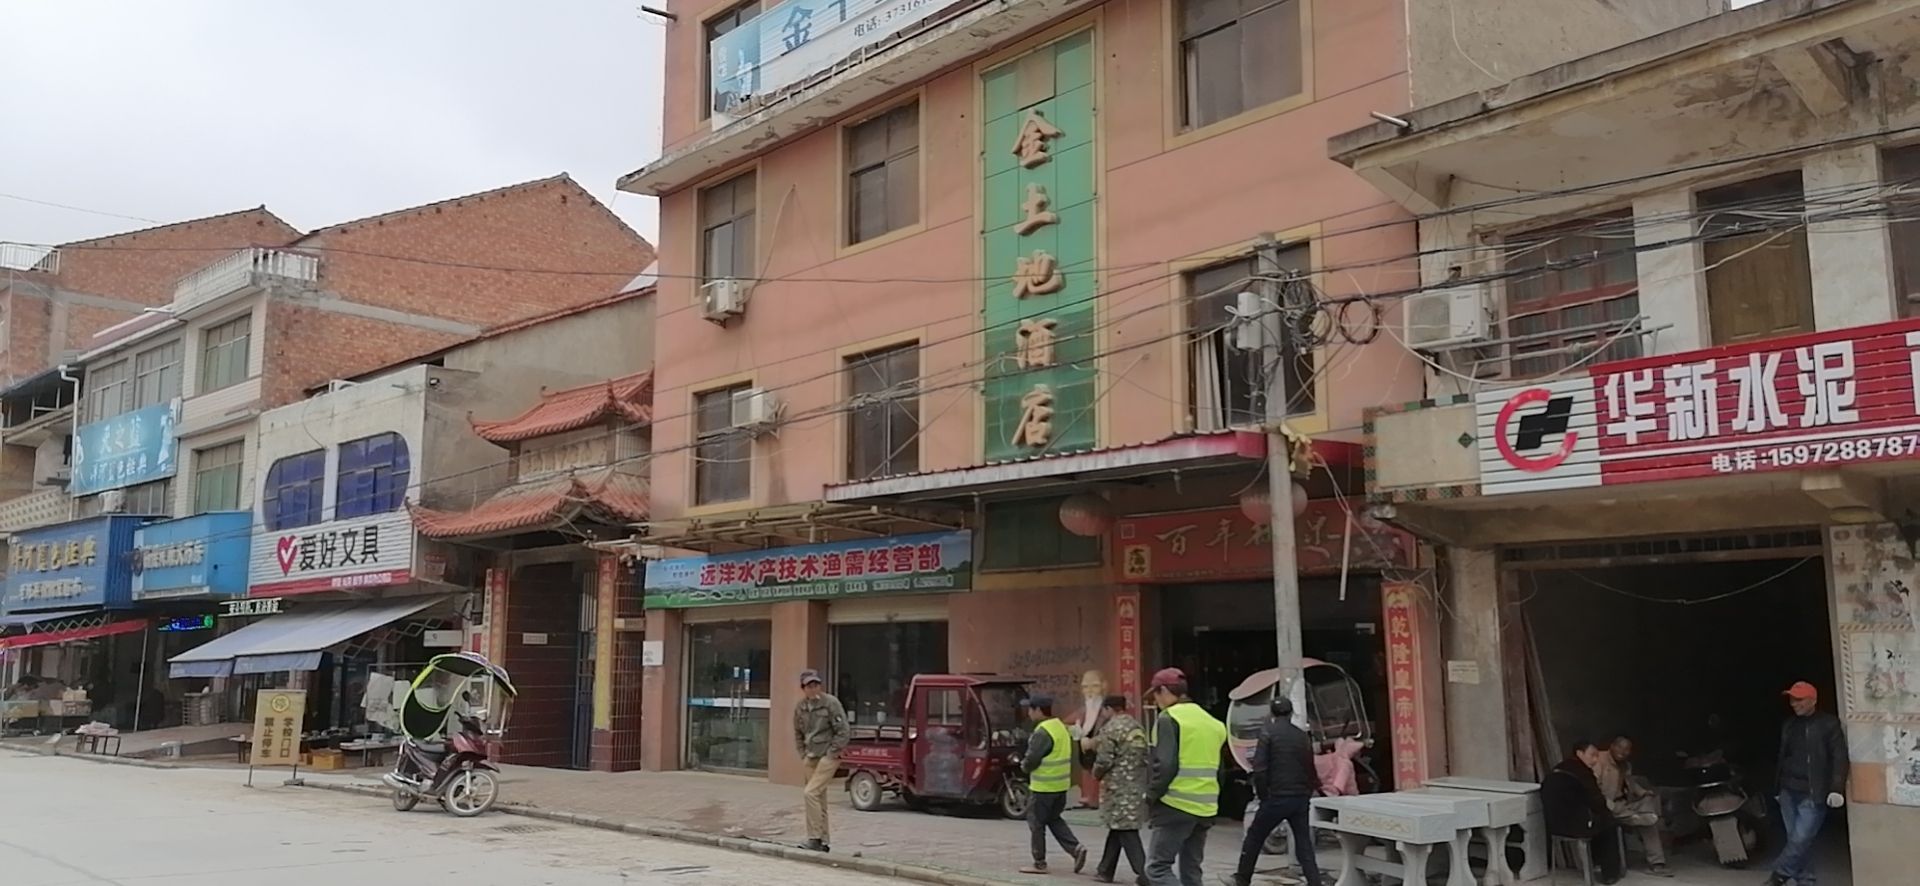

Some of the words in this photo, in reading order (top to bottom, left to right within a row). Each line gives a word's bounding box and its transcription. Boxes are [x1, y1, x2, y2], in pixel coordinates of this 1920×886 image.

[1604, 340, 1860, 445] 华新水泥
[298, 525, 380, 571] 爱好文具
[699, 543, 942, 587] 远洋水产技术渔需经营部
[280, 717, 294, 758] 学校门口
